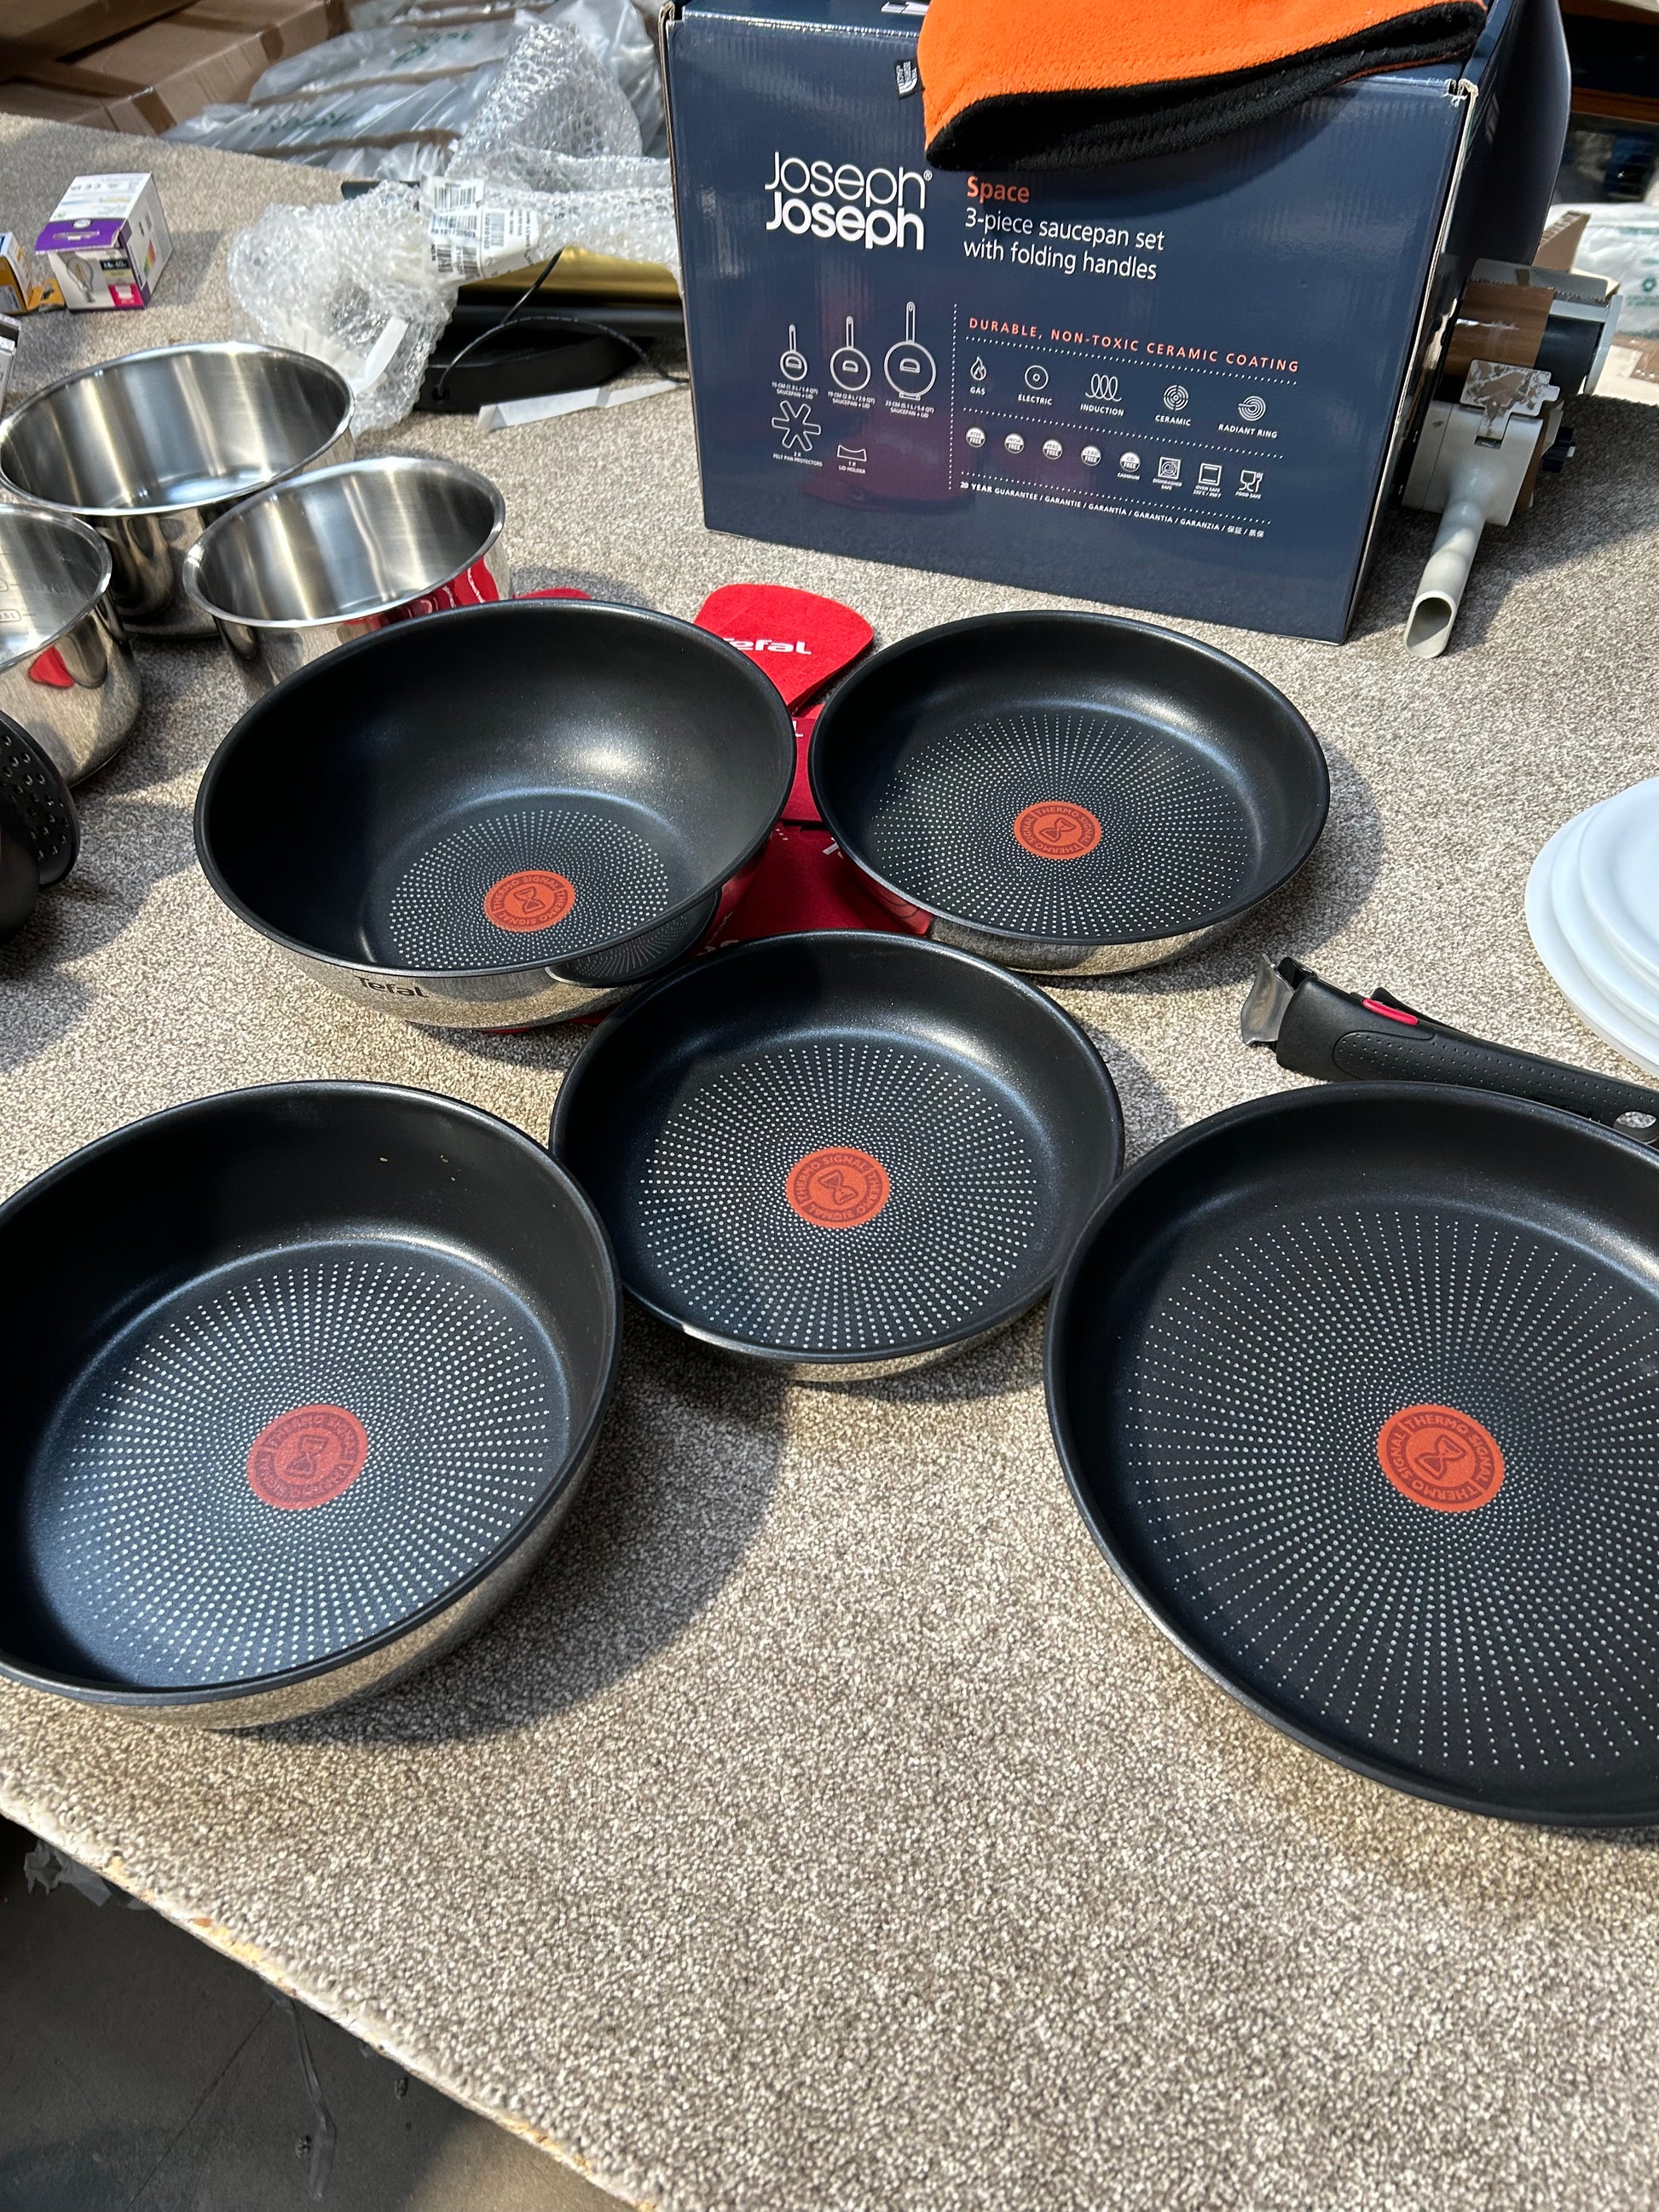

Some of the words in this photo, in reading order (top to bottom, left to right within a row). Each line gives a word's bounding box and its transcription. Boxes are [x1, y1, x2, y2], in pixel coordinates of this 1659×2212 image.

[966, 175, 1030, 204] Space
[766, 191, 925, 251] Joseph
[964, 207, 1033, 234] 3-piece
[1038, 220, 1130, 248] saucepan
[1135, 230, 1165, 251] set
[963, 237, 1004, 261] with
[1010, 241, 1076, 274] folding
[1082, 250, 1158, 280] handles
[968, 317, 1043, 340] DURABLE,
[1050, 328, 1139, 352] NON-TOXIC
[1147, 342, 1218, 362] CERAMIC
[1226, 352, 1299, 373] COATING
[969, 386, 986, 396] GAS
[1017, 394, 1053, 406] ELECTRIC
[1080, 403, 1124, 417] INDUCTION
[1154, 414, 1191, 427] CERAMIC
[969, 436, 981, 445] FREE
[1218, 423, 1255, 436] RADIANT
[1257, 429, 1277, 439] RING
[1008, 442, 1020, 451] FREE
[1046, 448, 1059, 457] FREE
[1084, 455, 1098, 464] FREE
[1123, 460, 1137, 470] FREE
[960, 481, 969, 489] 20
[971, 482, 993, 494] YEAR
[994, 488, 1038, 501] GUARANTEE
[1044, 495, 1082, 508] GARANTIE
[1134, 511, 1174, 523] GARANTIA
[1180, 517, 1220, 531] GARANZIA
[1022, 817, 1037, 843] SIGNAL
[1034, 806, 1079, 817] THERMO
[1078, 817, 1092, 843] SIGNAL
[1035, 842, 1082, 853] THERMO
[494, 880, 520, 910] THERMO
[522, 875, 559, 891] SIGNAL
[539, 890, 565, 921] THERMO
[498, 911, 537, 926] SIGNAL
[354, 975, 430, 998] Tefal
[796, 1161, 821, 1203] THERMO
[821, 1154, 867, 1170] SIGNAL
[855, 1171, 880, 1215] THERMO
[809, 1203, 855, 1221] SIGNAL
[1390, 1432, 1413, 1481] SIGNAL
[1404, 1414, 1470, 1435] THERMO
[1467, 1433, 1492, 1483] SIGNAL
[1411, 1479, 1478, 1500] THERMO
